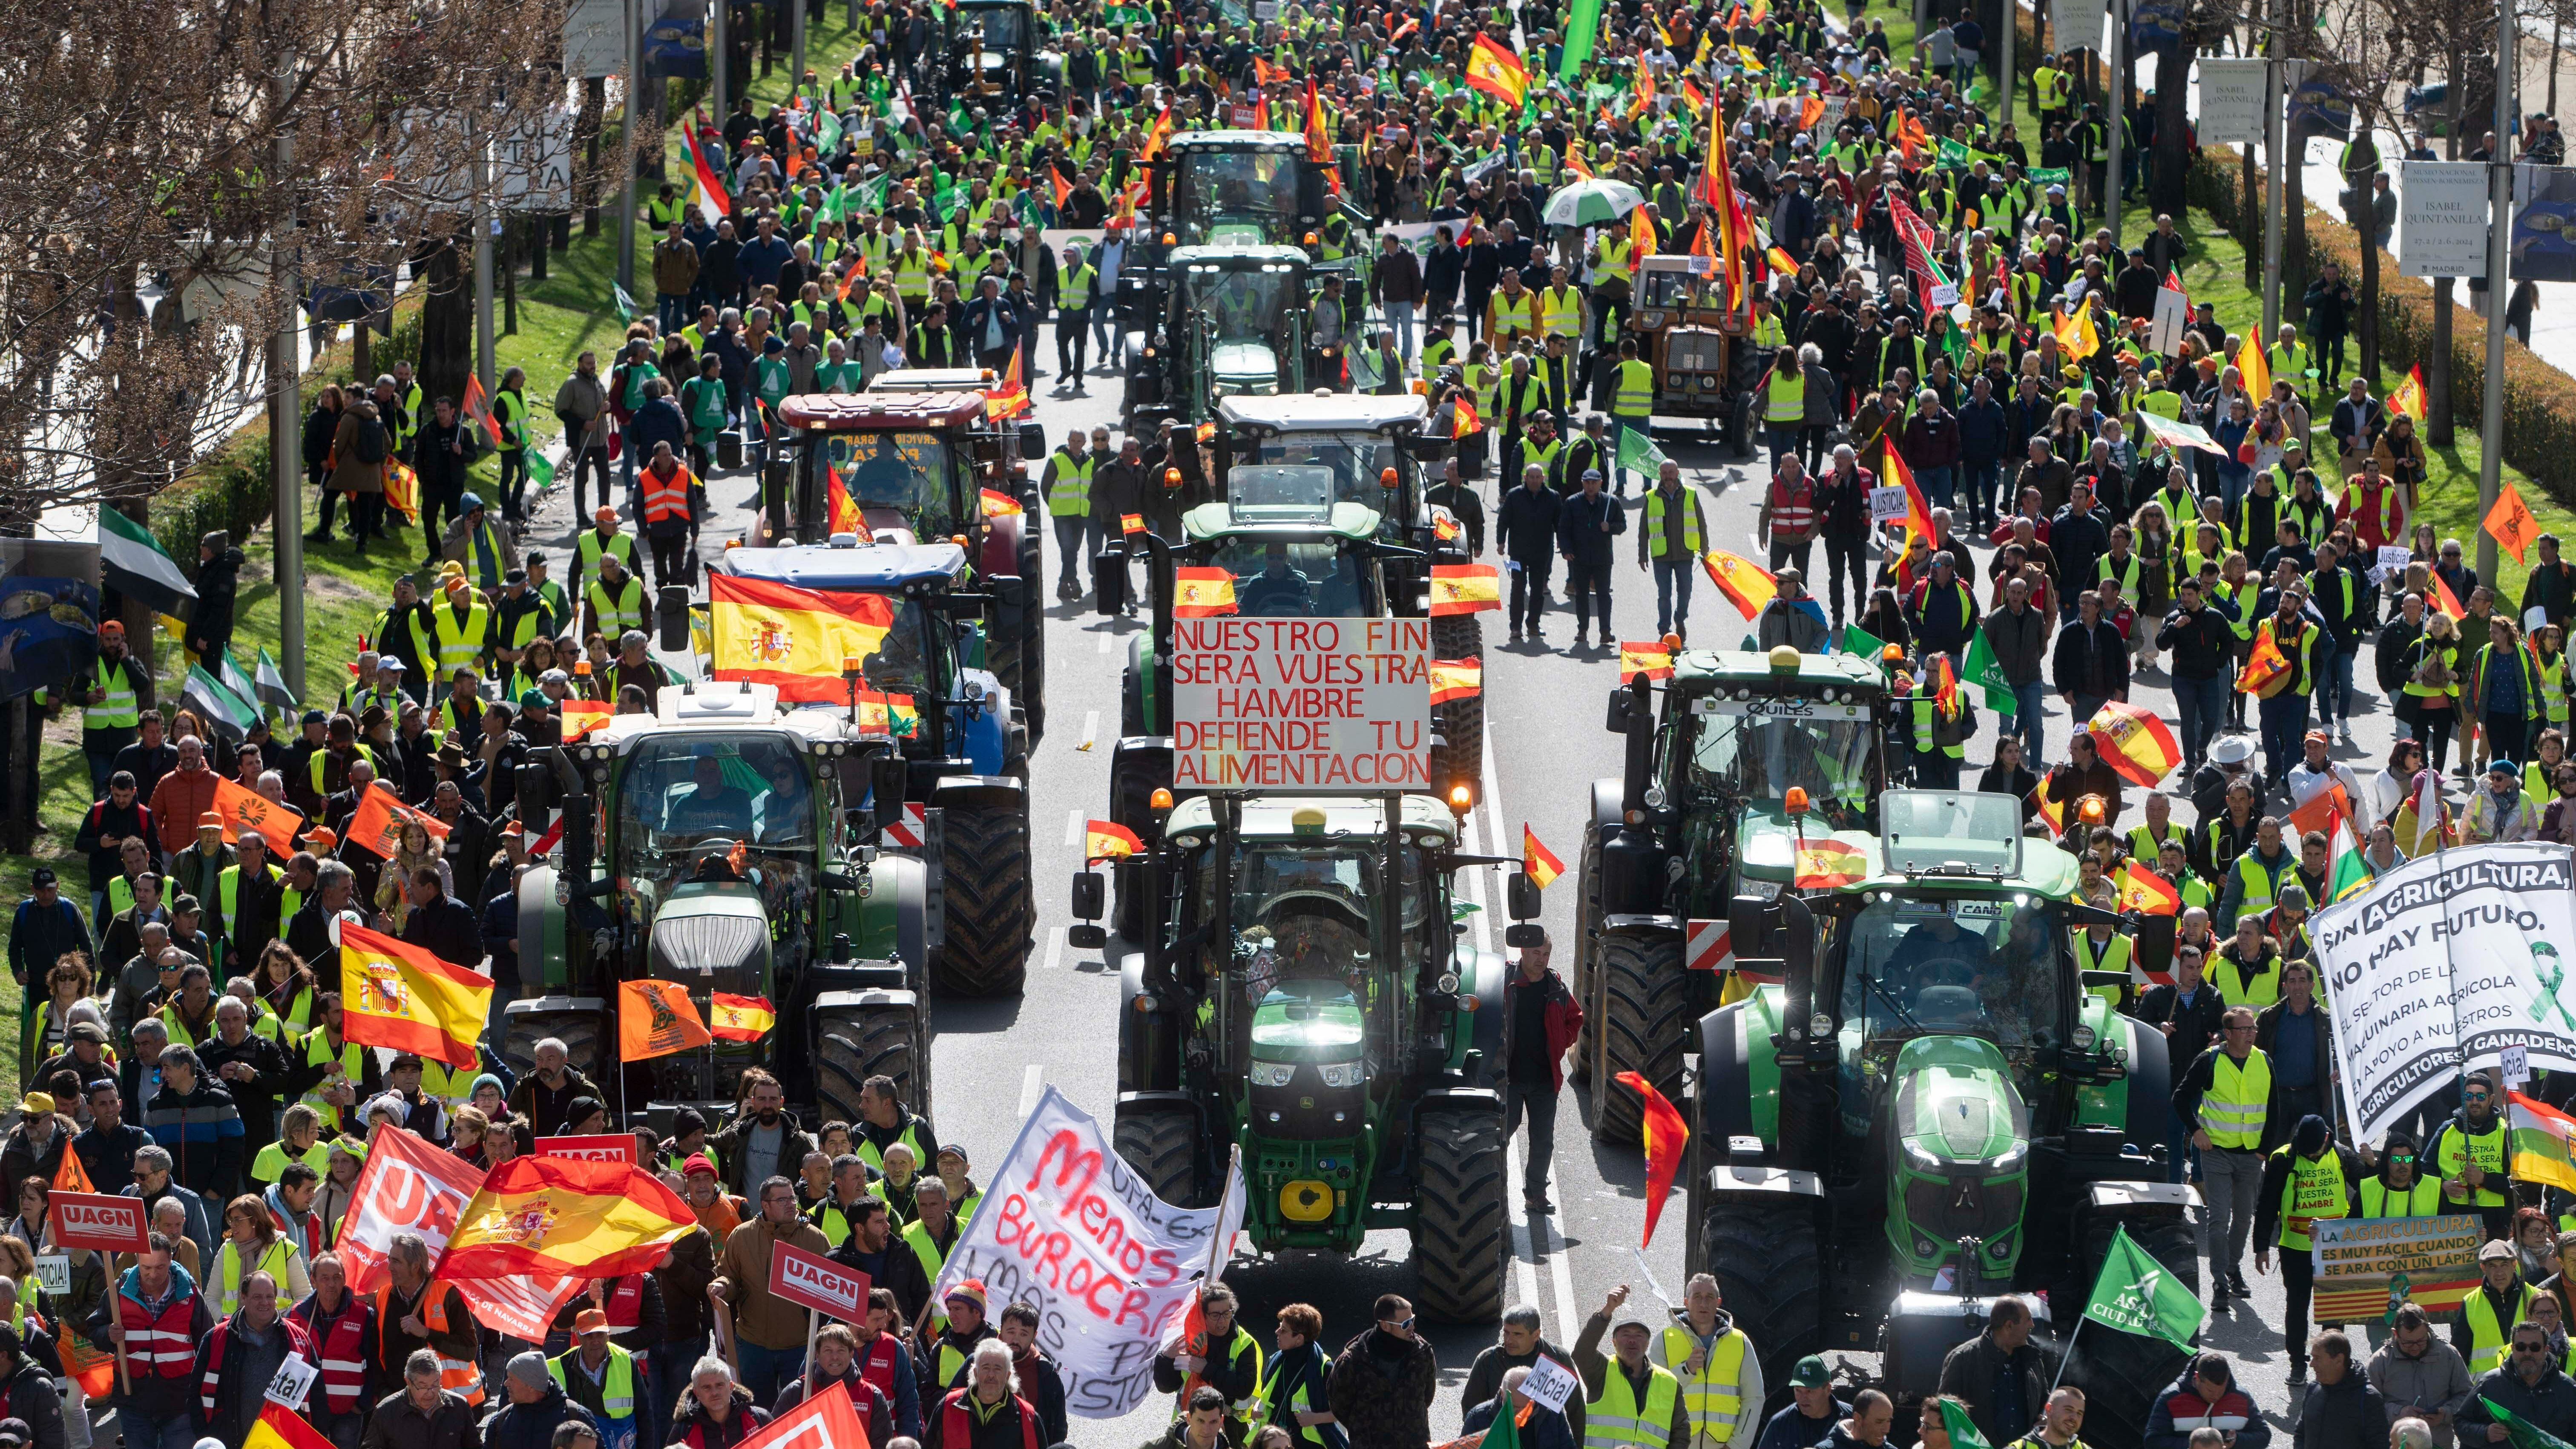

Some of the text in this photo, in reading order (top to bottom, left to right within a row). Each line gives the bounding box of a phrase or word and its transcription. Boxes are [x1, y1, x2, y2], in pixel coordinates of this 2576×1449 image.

[1237, 110, 1255, 118] UAG
[2202, 95, 2263, 106] QUINTANILLA
[2405, 213, 2483, 225] QUINTANILLA
[2426, 201, 2463, 211] ISABEL
[1872, 490, 1906, 515] ¡JUSTICIA!
[2378, 549, 2409, 565] Justicia!
[1174, 621, 1427, 651] NUESTRO FIN
[1174, 653, 1431, 684] SERA VUESTRA
[1217, 688, 1364, 718] HAMBRE
[1745, 702, 1814, 716] QUILES
[1174, 719, 1419, 751] DEFIENDE TU
[1174, 753, 1431, 784] ALIMENTACION
[2323, 865, 2571, 954] SIN AGRICULTURA,
[2331, 904, 2545, 997] NO HAY FUTURO.
[2352, 977, 2403, 1024] SETOR
[2408, 967, 2432, 984] DE
[2438, 963, 2458, 978] LA
[2413, 1029, 2424, 1044] A
[2427, 1004, 2513, 1038] NUESTROS
[2501, 1049, 2528, 1079] icia!
[2359, 1051, 2464, 1126] AGRICULTORES
[2463, 1041, 2472, 1057] Y
[2318, 1176, 2340, 1188] SERÁ
[64, 1207, 133, 1227] UAGN
[1025, 1128, 1179, 1288] Menos
[2322, 1214, 2477, 1243] LA AGRICULTURA
[348, 1245, 374, 1266] UNIÓN
[2322, 1236, 2476, 1261] ES MUY FÁCIL CUANDO
[37, 1263, 67, 1285] STICIA!
[2325, 1251, 2475, 1276] SE ARA CON UN LÁPIZ
[787, 1259, 857, 1300] UAGN
[481, 1300, 494, 1312] DE
[494, 1306, 535, 1335] NAVARRA
[2092, 1303, 2144, 1327] CIUDAD
[1526, 1361, 1574, 1405] Justicia!
